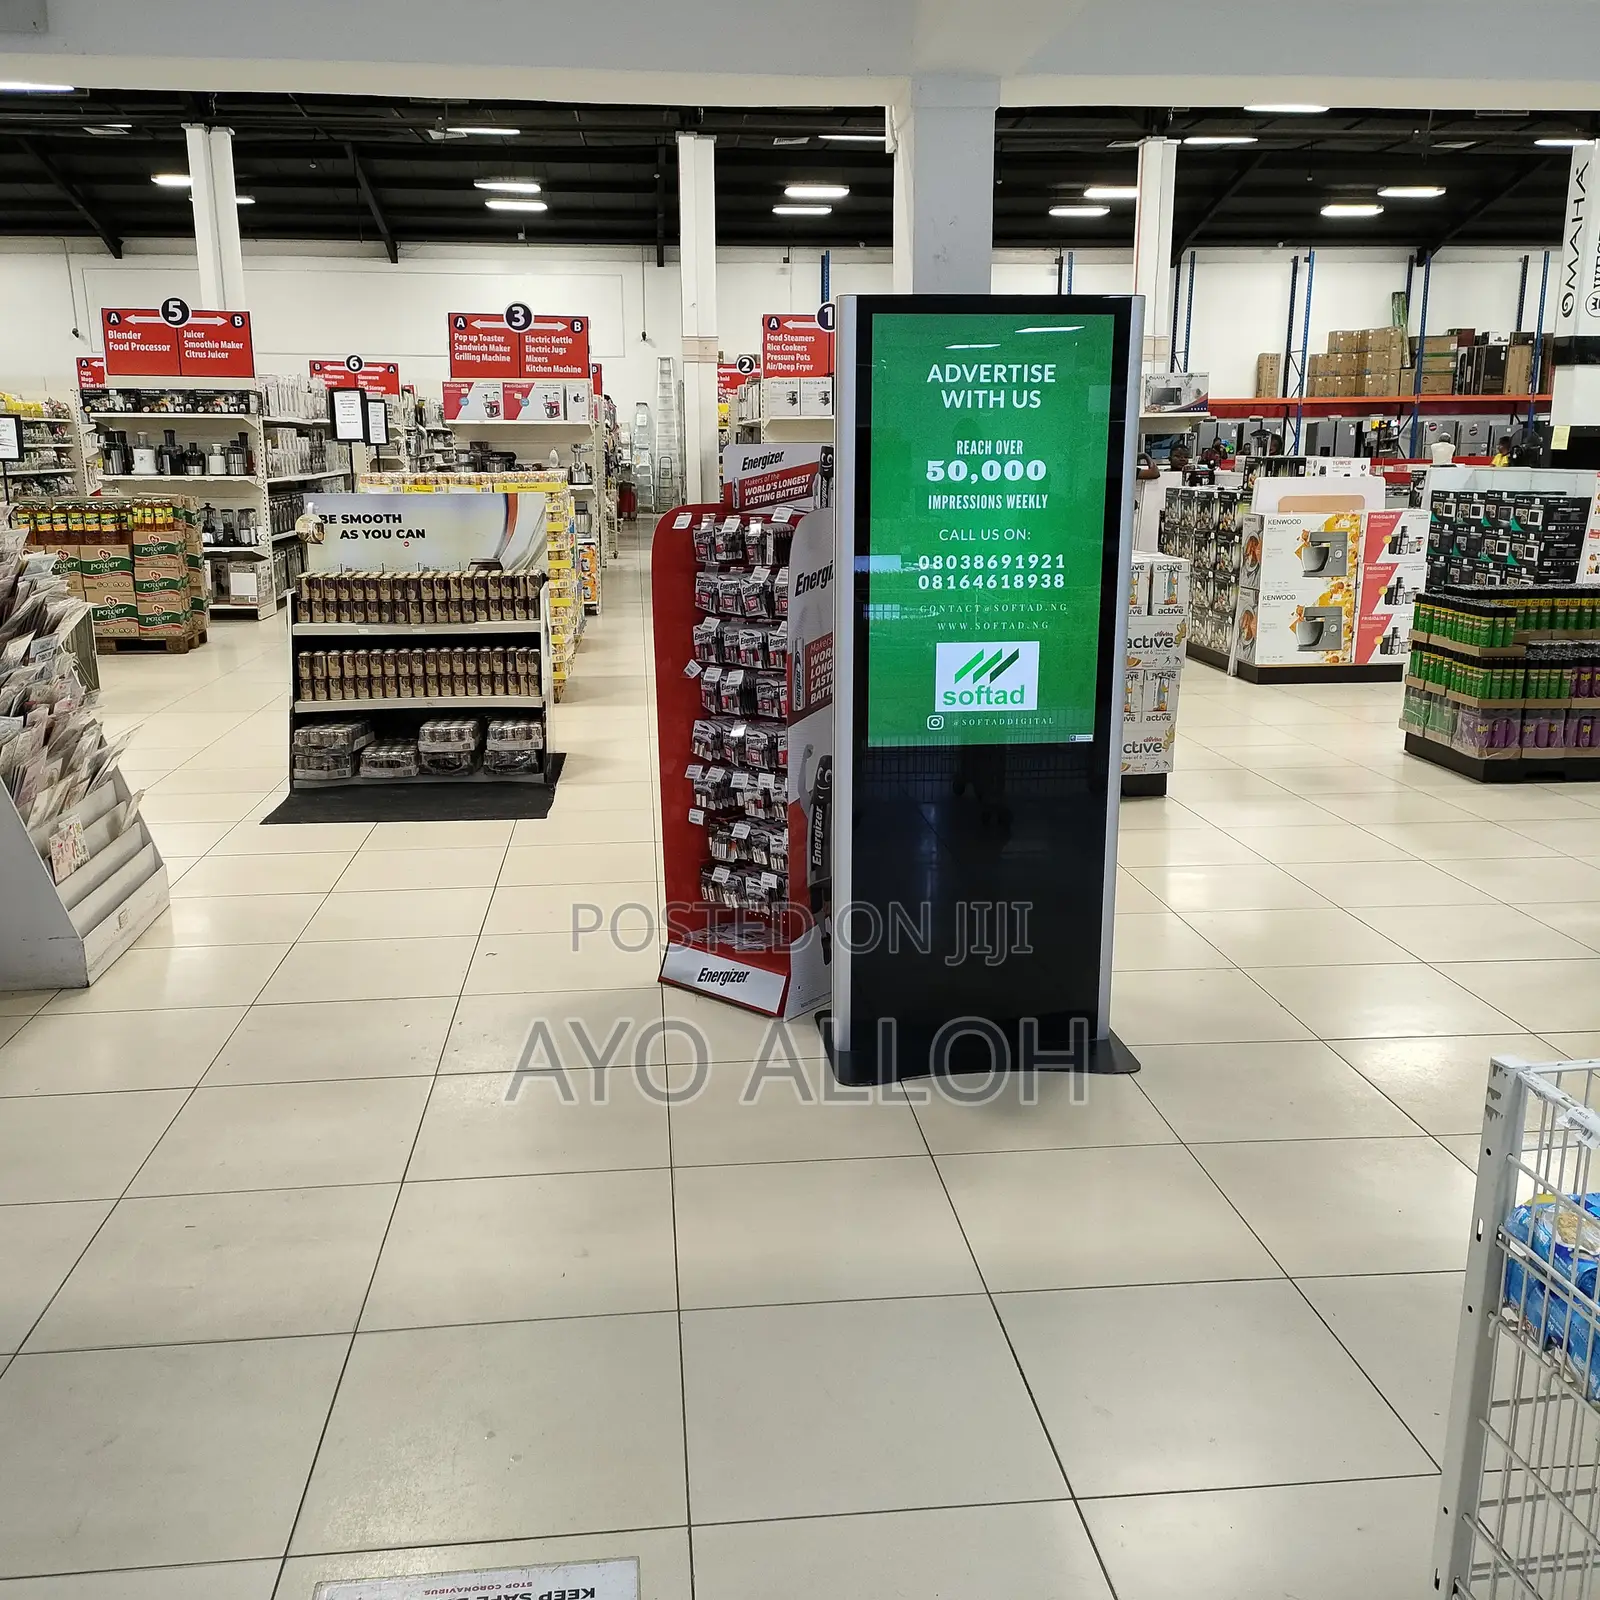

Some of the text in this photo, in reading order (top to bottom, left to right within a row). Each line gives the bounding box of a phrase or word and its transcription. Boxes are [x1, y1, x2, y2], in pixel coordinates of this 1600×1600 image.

[1562, 161, 1589, 318] OMAHA
[168, 300, 182, 321] 5
[512, 306, 525, 326] 3
[824, 306, 832, 326] 1
[110, 313, 119, 323] A
[234, 316, 242, 326] B
[456, 318, 465, 328] A
[770, 318, 778, 328] A
[574, 322, 582, 331] B
[108, 330, 142, 340] Blender
[183, 330, 204, 339] Juicer
[454, 334, 504, 344] Pop up Toaster
[525, 336, 572, 344] Electric Kettle
[109, 342, 170, 352] Food Processor
[184, 340, 244, 349] Smoothie Maker
[454, 343, 510, 352] Sandwich Maker
[551, 346, 567, 354] Jugs
[350, 357, 359, 370] 6
[455, 353, 510, 362] Grilling Machine
[741, 359, 750, 371] 2
[766, 363, 813, 372] Air/Deep Fryer
[926, 364, 1057, 383] ADVERTISE
[941, 390, 1041, 409] WITH US
[956, 440, 1023, 455] REACH OVER
[742, 451, 784, 471] Energizer
[926, 460, 1046, 484] 50,000
[744, 477, 763, 486] Makers
[745, 474, 810, 496] WORLD'S LONGEST
[745, 492, 775, 506] LASTING
[776, 484, 808, 499] BATTERY
[928, 494, 1048, 509] IMPRESSIONS WEEKLY
[319, 514, 402, 524] BE SMOOTH
[340, 529, 425, 539] AS YOU CAN
[939, 529, 1031, 540] CALL US ON:
[918, 554, 1064, 570] 08038691921
[918, 574, 1064, 590] 08164618938
[920, 603, 1067, 613] CONTACT@SOFTAD.NG
[938, 621, 1049, 630] WWW.SOFTAD.NG
[810, 636, 832, 653] Makers
[1127, 635, 1173, 648] active
[943, 685, 1025, 705] softad
[953, 718, 1054, 726] @SOFTADDIGITAL
[1123, 741, 1162, 753] ctive
[812, 804, 824, 866] Energizer
[697, 968, 750, 985] Energizer
[539, 1587, 596, 1600] KEEP
